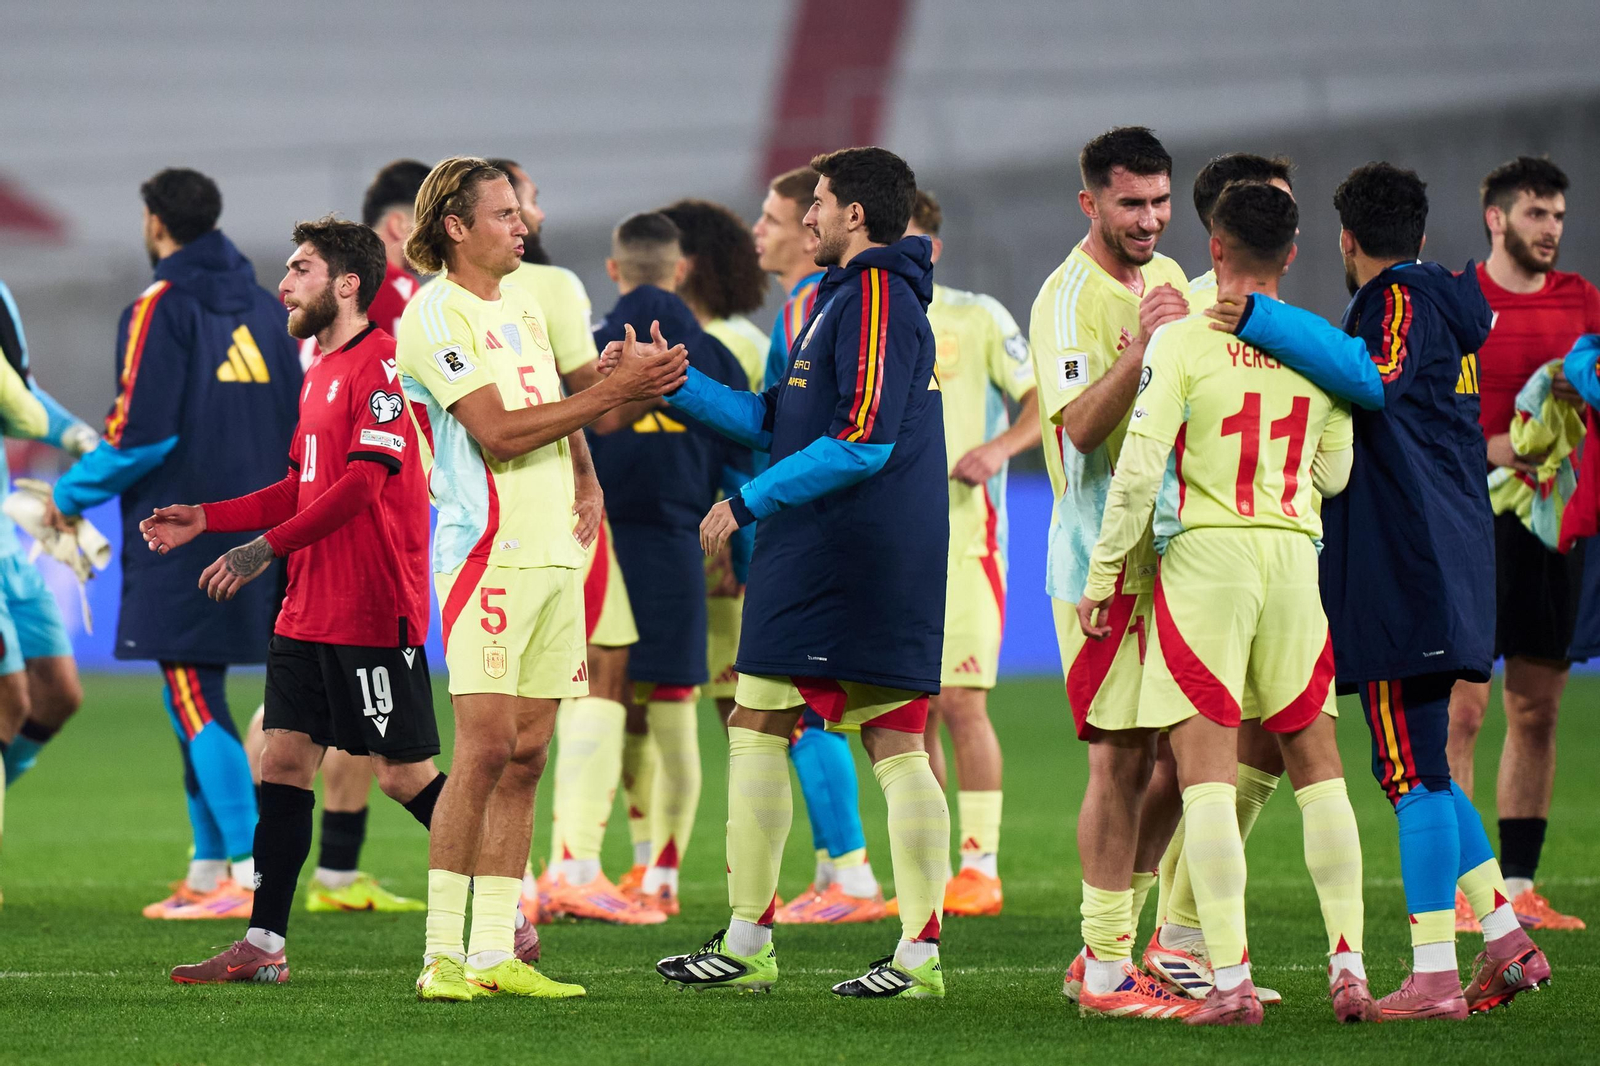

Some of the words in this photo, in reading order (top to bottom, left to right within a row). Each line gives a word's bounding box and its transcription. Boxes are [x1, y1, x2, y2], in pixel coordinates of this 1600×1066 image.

[1227, 342, 1281, 369] YERE
[517, 365, 543, 407] 5
[1220, 392, 1311, 518] 11
[480, 587, 507, 635] 5
[356, 666, 393, 716] 19
